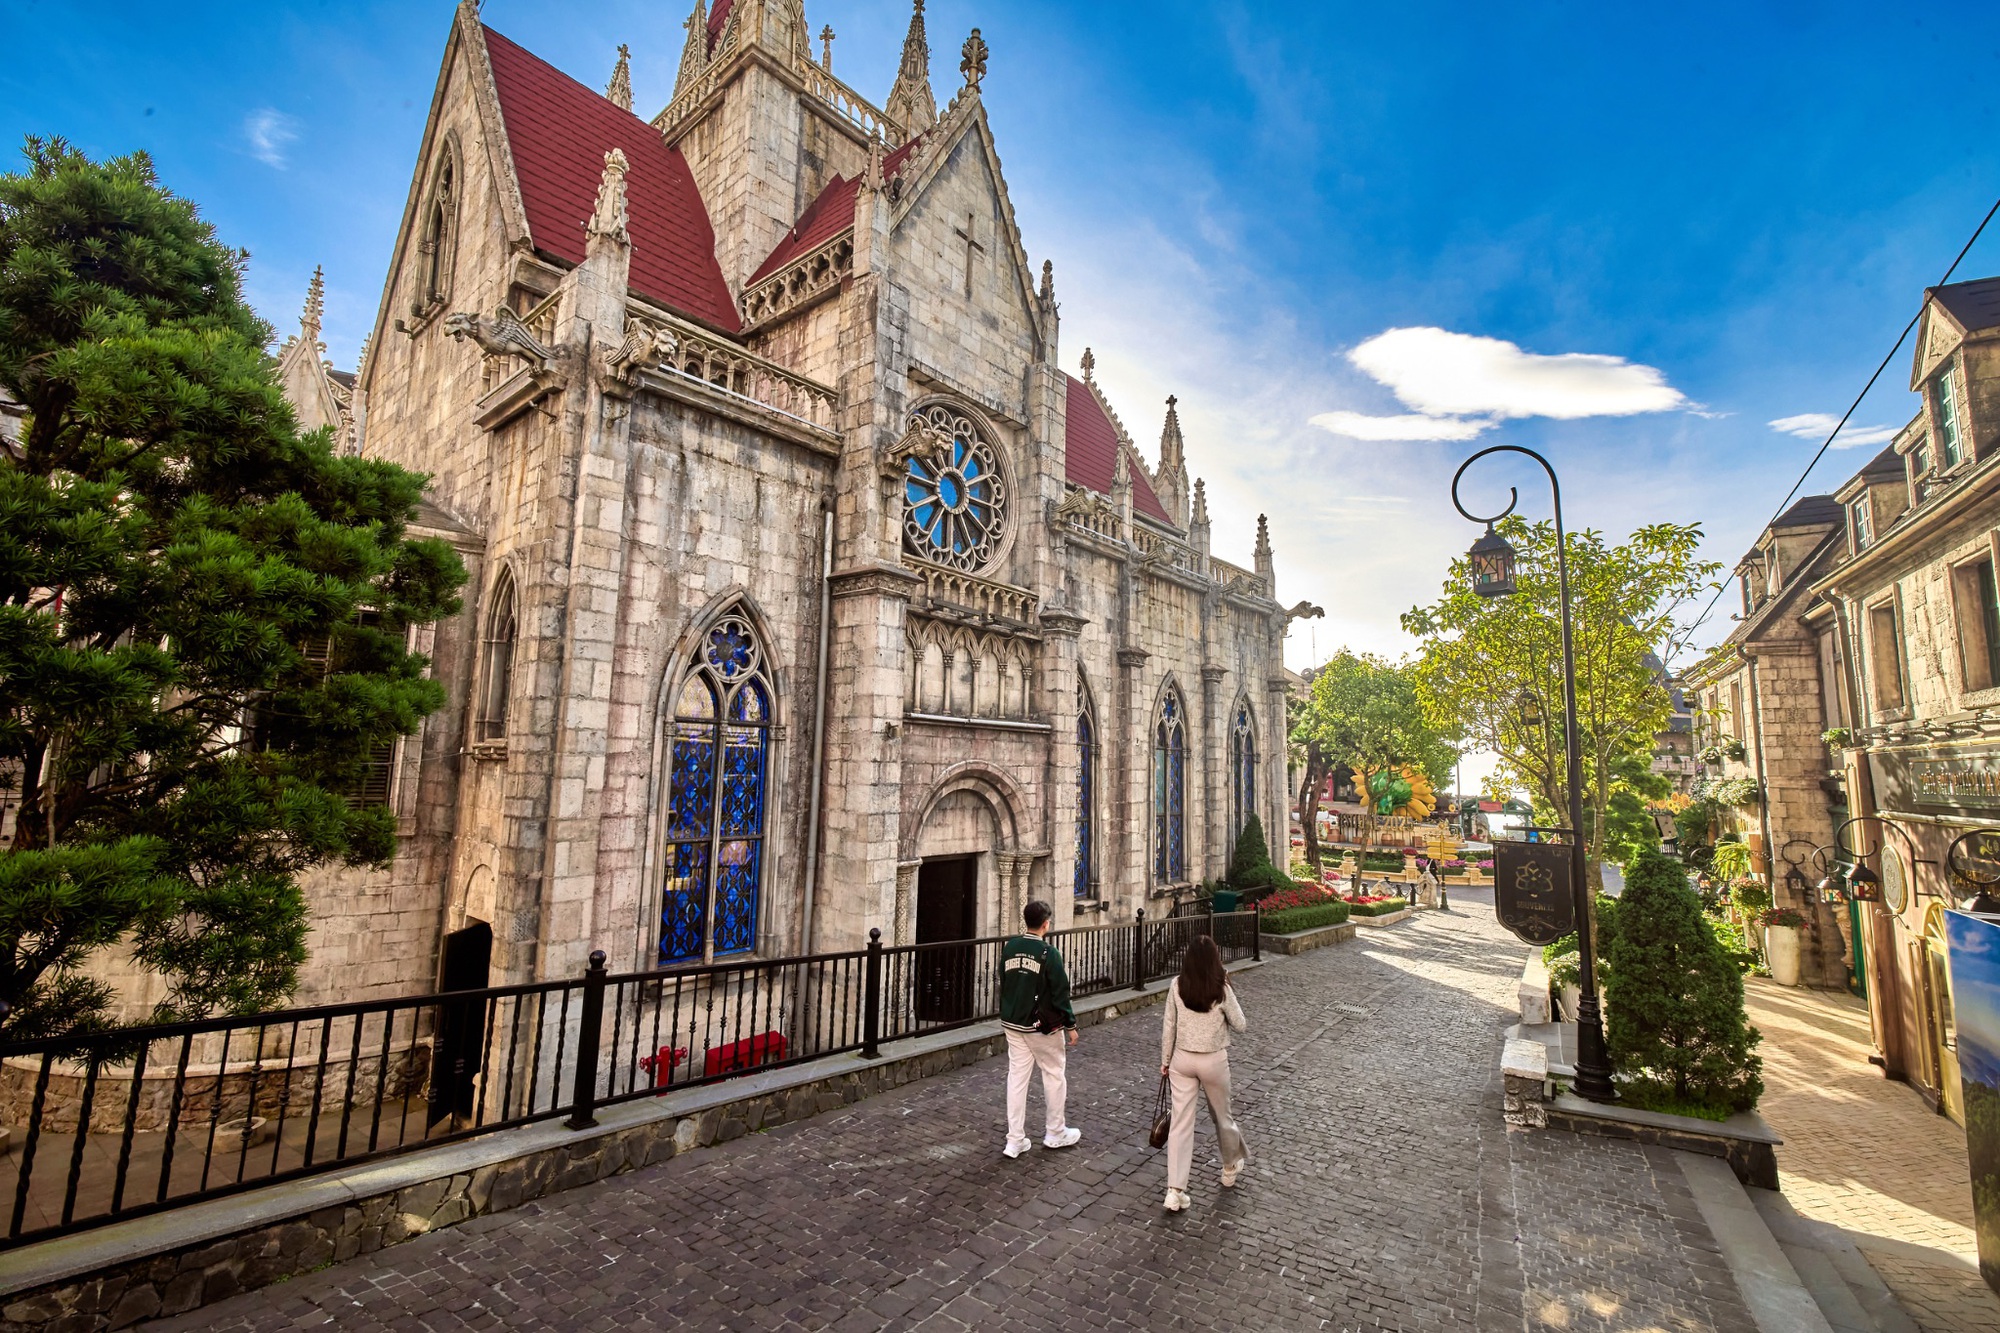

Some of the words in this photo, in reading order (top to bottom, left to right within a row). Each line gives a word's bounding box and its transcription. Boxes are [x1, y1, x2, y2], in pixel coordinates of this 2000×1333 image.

[1382, 815, 1414, 832] 2025
[1005, 957, 1021, 972] HIGH
[1022, 957, 1041, 974] SCHOO
